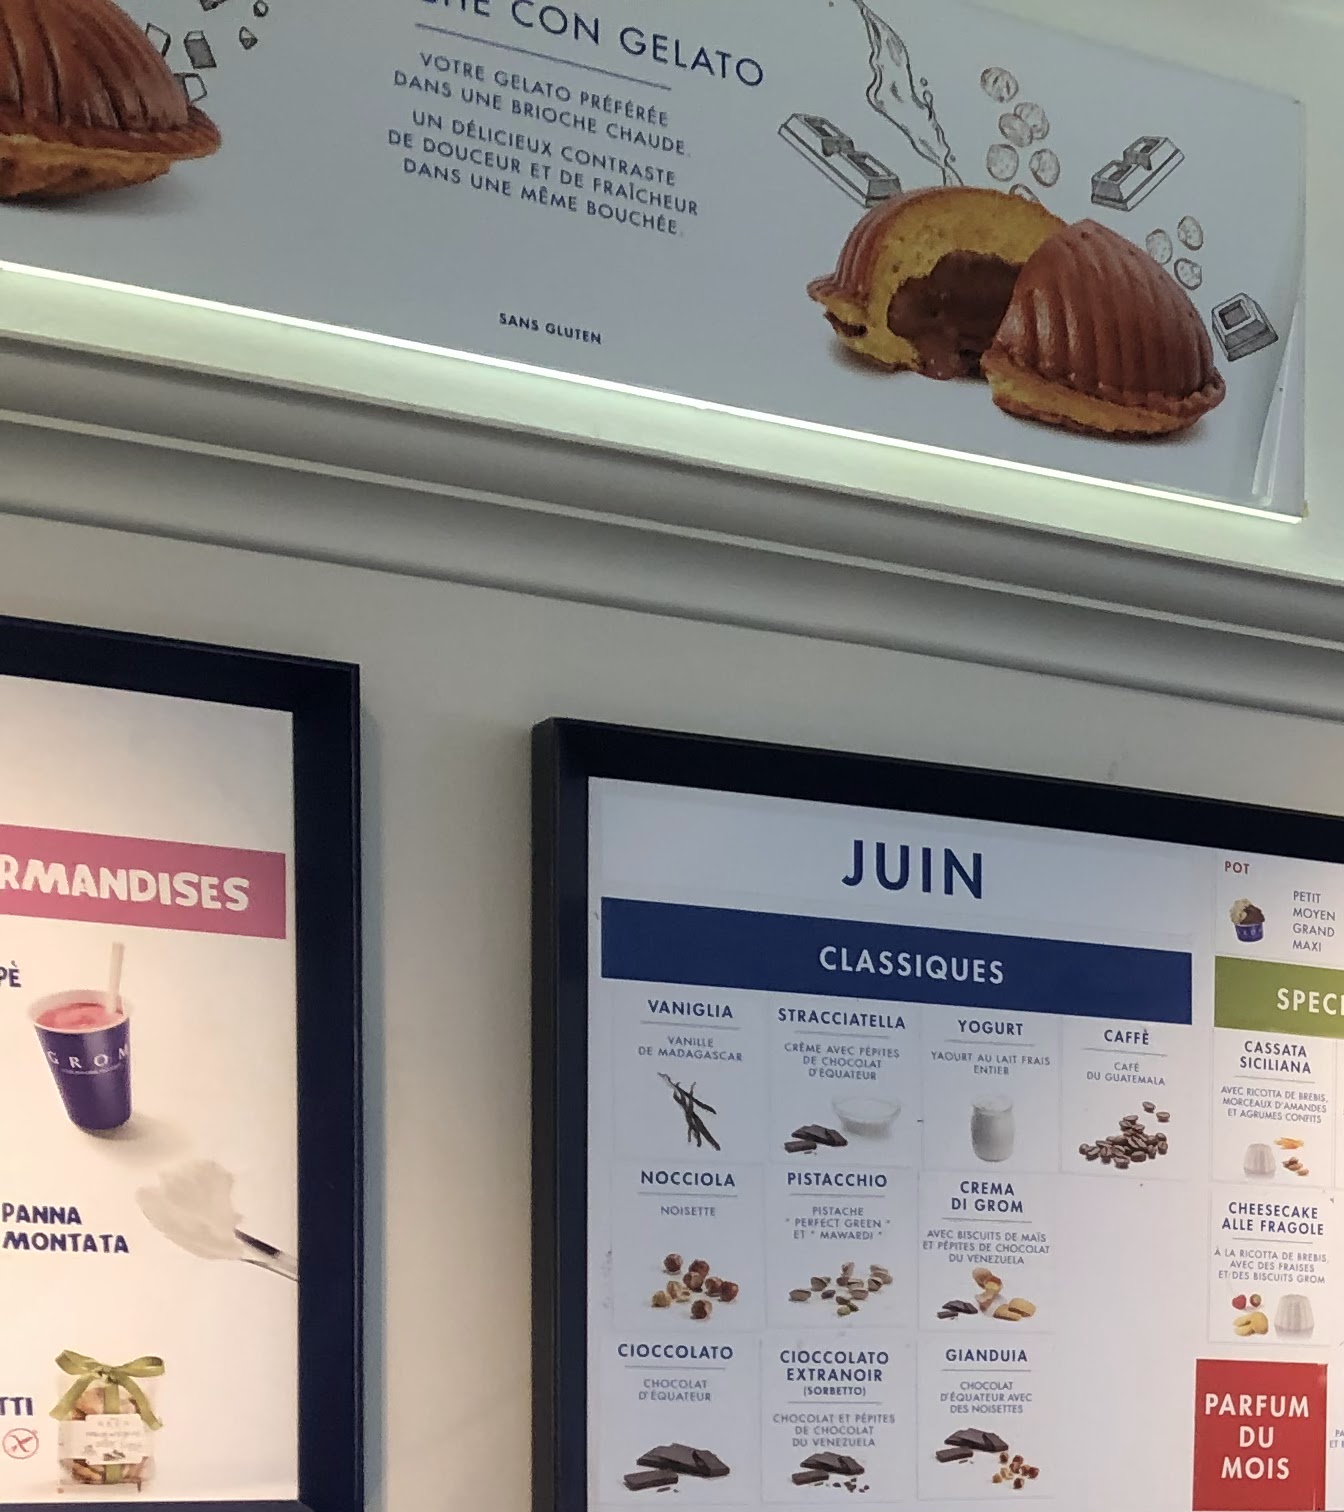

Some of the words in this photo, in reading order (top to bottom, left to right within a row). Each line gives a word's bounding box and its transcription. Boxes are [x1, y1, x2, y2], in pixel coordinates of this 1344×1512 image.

[511, 0, 600, 44] CON
[619, 26, 763, 87] GELATO
[419, 51, 485, 82] VOTRE
[494, 70, 571, 102] GELATO
[580, 91, 669, 128] PRÉFÉRÉE
[393, 69, 452, 99] DANS
[461, 87, 502, 112] UNE
[511, 98, 597, 134] BRIOCHE
[412, 109, 442, 130] UN
[451, 117, 553, 156] DÉLICIEUX
[561, 145, 676, 187] CONTRASTE
[388, 129, 414, 148] DE
[422, 136, 521, 174] DOUCEUR
[530, 162, 551, 181] ET
[559, 168, 584, 190] DE
[593, 176, 698, 217] FRAÎCHEUR
[403, 157, 462, 185] DANS
[470, 174, 512, 197] UNE
[520, 185, 578, 212] MÊME
[499, 312, 539, 331] SANS
[545, 322, 601, 345] GLUTEN
[841, 839, 982, 900] JUIN
[1224, 860, 1250, 875] POT
[0, 853, 250, 912] RMANDISES
[1293, 890, 1321, 904] PETIT
[1293, 907, 1336, 921] MOYEN
[1292, 923, 1335, 938] GRAND
[1293, 939, 1322, 952] MAXI
[819, 945, 1004, 985] CLASSIQUES
[647, 999, 733, 1019] VANIGLIA
[778, 1007, 906, 1030] STRACCIATELLA
[957, 1019, 1024, 1036] YOGURT
[667, 1036, 714, 1048] VANILLE
[1103, 1028, 1150, 1046] CAFFÈ
[638, 1046, 653, 1056] DE
[658, 1048, 743, 1062] MADAGASCAR
[1244, 1040, 1307, 1058] CASSATA
[931, 1050, 973, 1062] YAOURT
[977, 1053, 992, 1063] AU
[995, 1054, 1017, 1065] LAIT
[1021, 1055, 1051, 1067] FRAIS
[1114, 1060, 1139, 1073] CAFÉ
[1240, 1056, 1312, 1074] SICILIANA
[973, 1065, 1009, 1076] ENTIER
[1086, 1071, 1101, 1081] DU
[1104, 1072, 1166, 1086] GUATEMALA
[640, 1170, 736, 1188] NOCCIOLA
[787, 1172, 888, 1188] PISTACCHIO
[960, 1180, 1015, 1196] CREMA
[660, 1205, 716, 1217] NOISETTE
[812, 1206, 864, 1217] PISTACHE
[951, 1197, 967, 1211] DI
[974, 1198, 1024, 1213] GROM
[1228, 1201, 1319, 1220] CHEESECAKE
[1, 1202, 82, 1226] PANNA
[1221, 1217, 1254, 1231] ALLE
[1260, 1219, 1325, 1236] FRAGOLE
[2, 1231, 130, 1254] MONTATA
[617, 1343, 734, 1360] CIOCCOLATO
[780, 1350, 889, 1365] CIOCCOLATO
[945, 1348, 1028, 1363] GIANDUIA
[643, 1378, 708, 1390] CHOCOLAT
[787, 1368, 883, 1383] EXTRANOIR
[803, 1385, 867, 1397] (SORBETTO)
[1205, 1393, 1309, 1418] PARFUM
[773, 1413, 834, 1424] CHOCOLAT
[838, 1413, 852, 1423] ET
[855, 1412, 896, 1424] PÉPITES
[795, 1426, 809, 1435] DE
[813, 1425, 874, 1436] CHOCOLAT
[1239, 1425, 1274, 1448] DU
[792, 1437, 808, 1448] DU
[812, 1438, 876, 1448] VENEZUELA
[1220, 1456, 1290, 1480] MOIS
